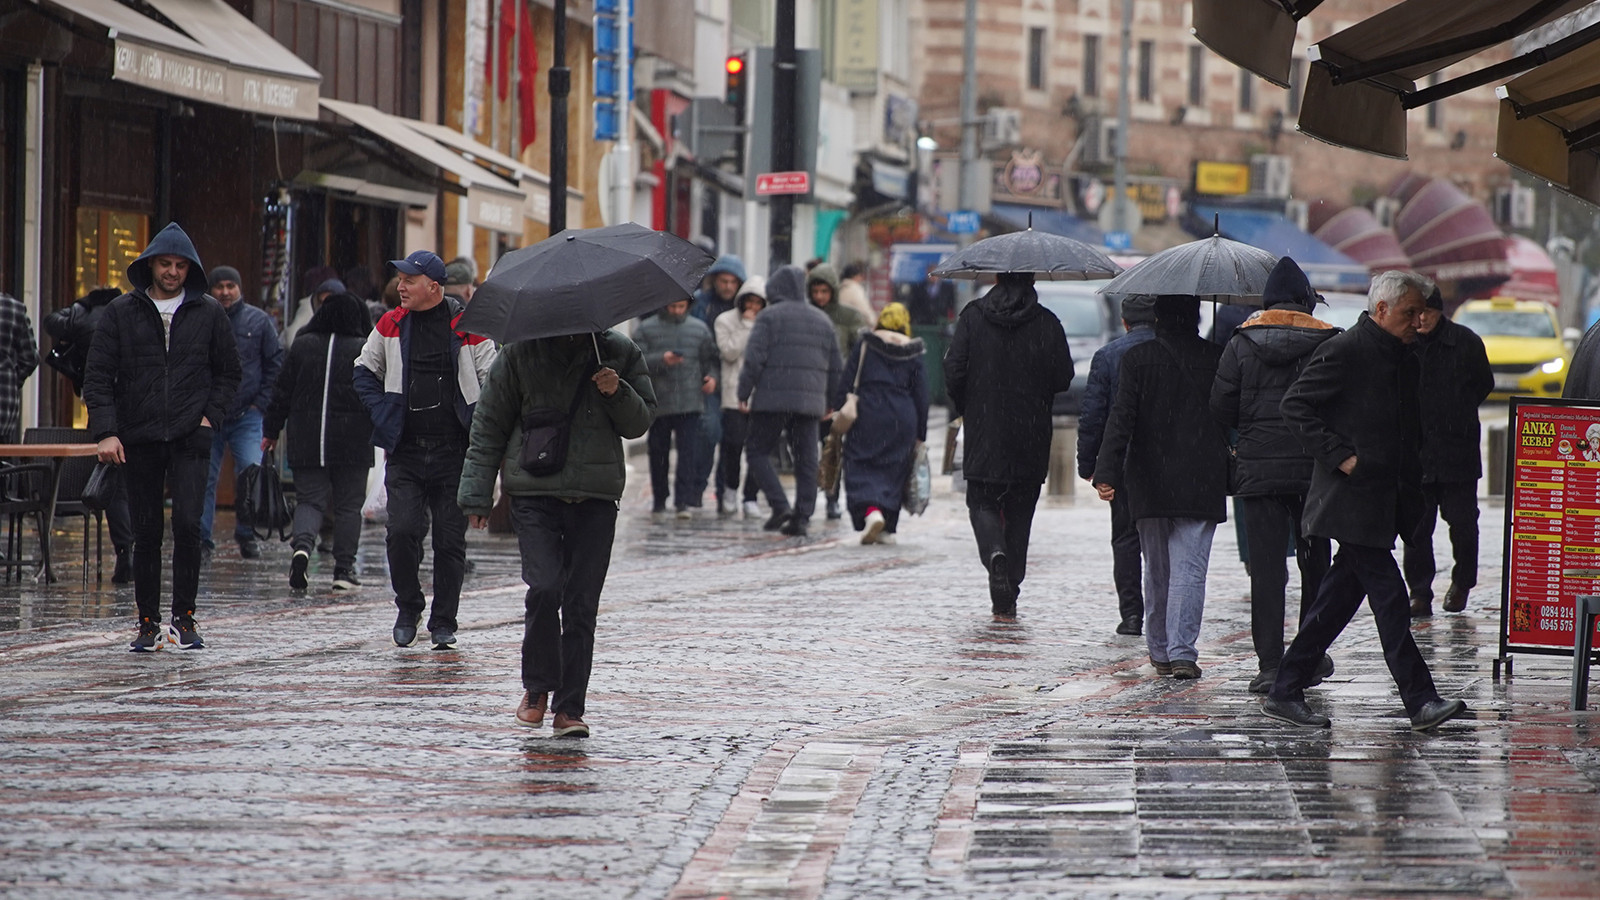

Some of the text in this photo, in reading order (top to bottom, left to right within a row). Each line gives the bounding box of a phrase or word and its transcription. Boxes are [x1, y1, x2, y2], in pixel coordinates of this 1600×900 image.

[140, 52, 162, 80] AYGÜN
[164, 60, 194, 88] AYAKKABI
[196, 68, 201, 90] &
[202, 69, 223, 97] ÇANTA
[1522, 421, 1556, 435] ANKA
[1522, 436, 1554, 447] KEBAP
[1541, 606, 1574, 618] 0284 214
[1540, 619, 1573, 631] 0545 575
